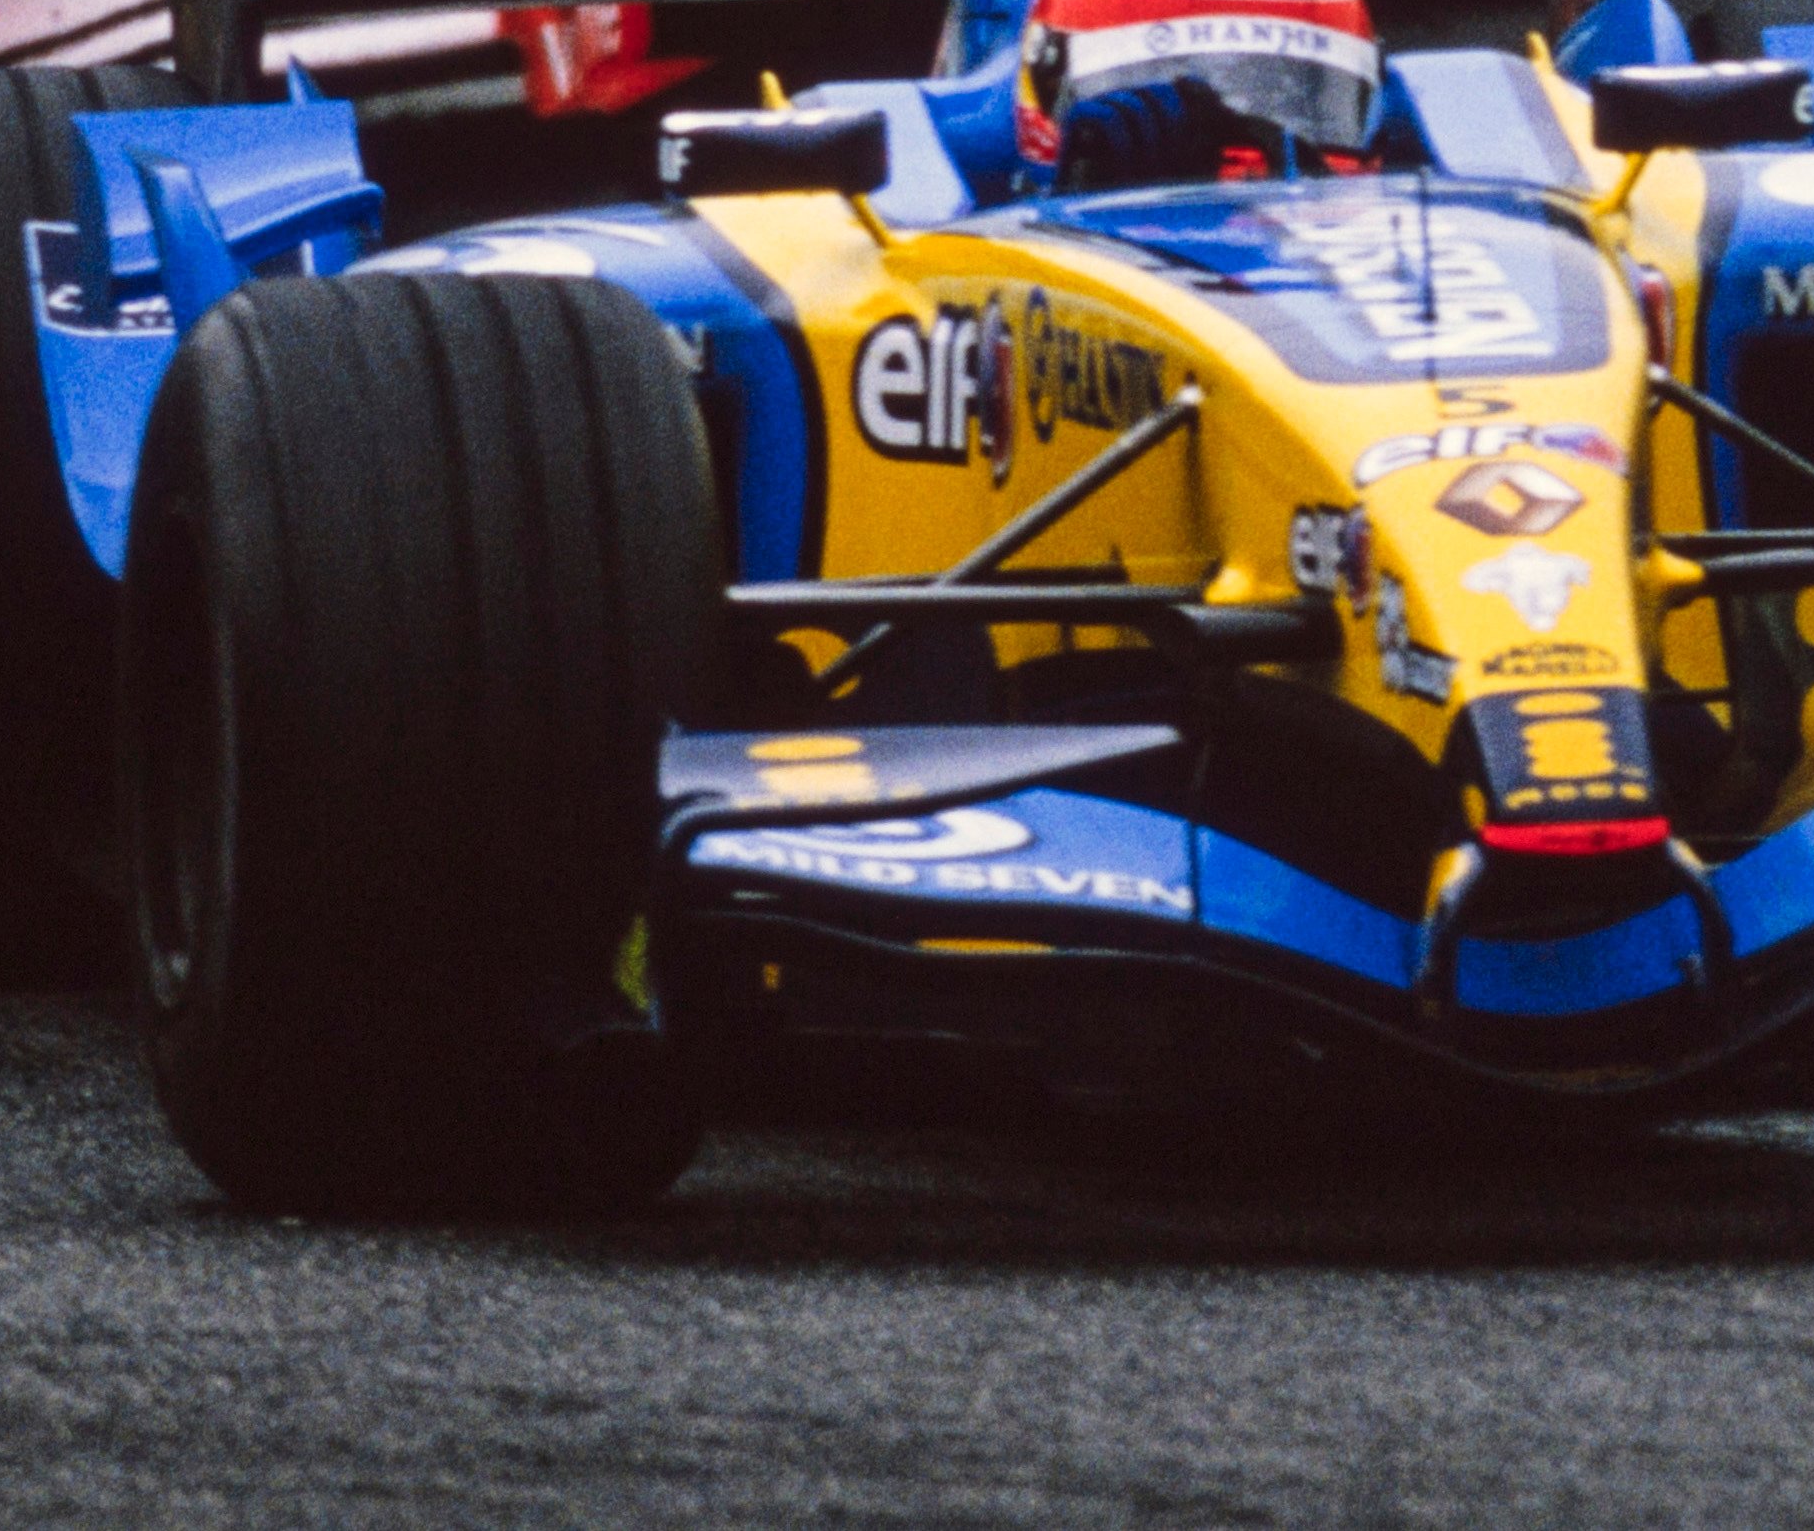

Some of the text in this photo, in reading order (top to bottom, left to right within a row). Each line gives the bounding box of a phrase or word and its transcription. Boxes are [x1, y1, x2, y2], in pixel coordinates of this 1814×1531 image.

[854, 316, 980, 454] elf
[710, 834, 1194, 912] MILD SEVEN
